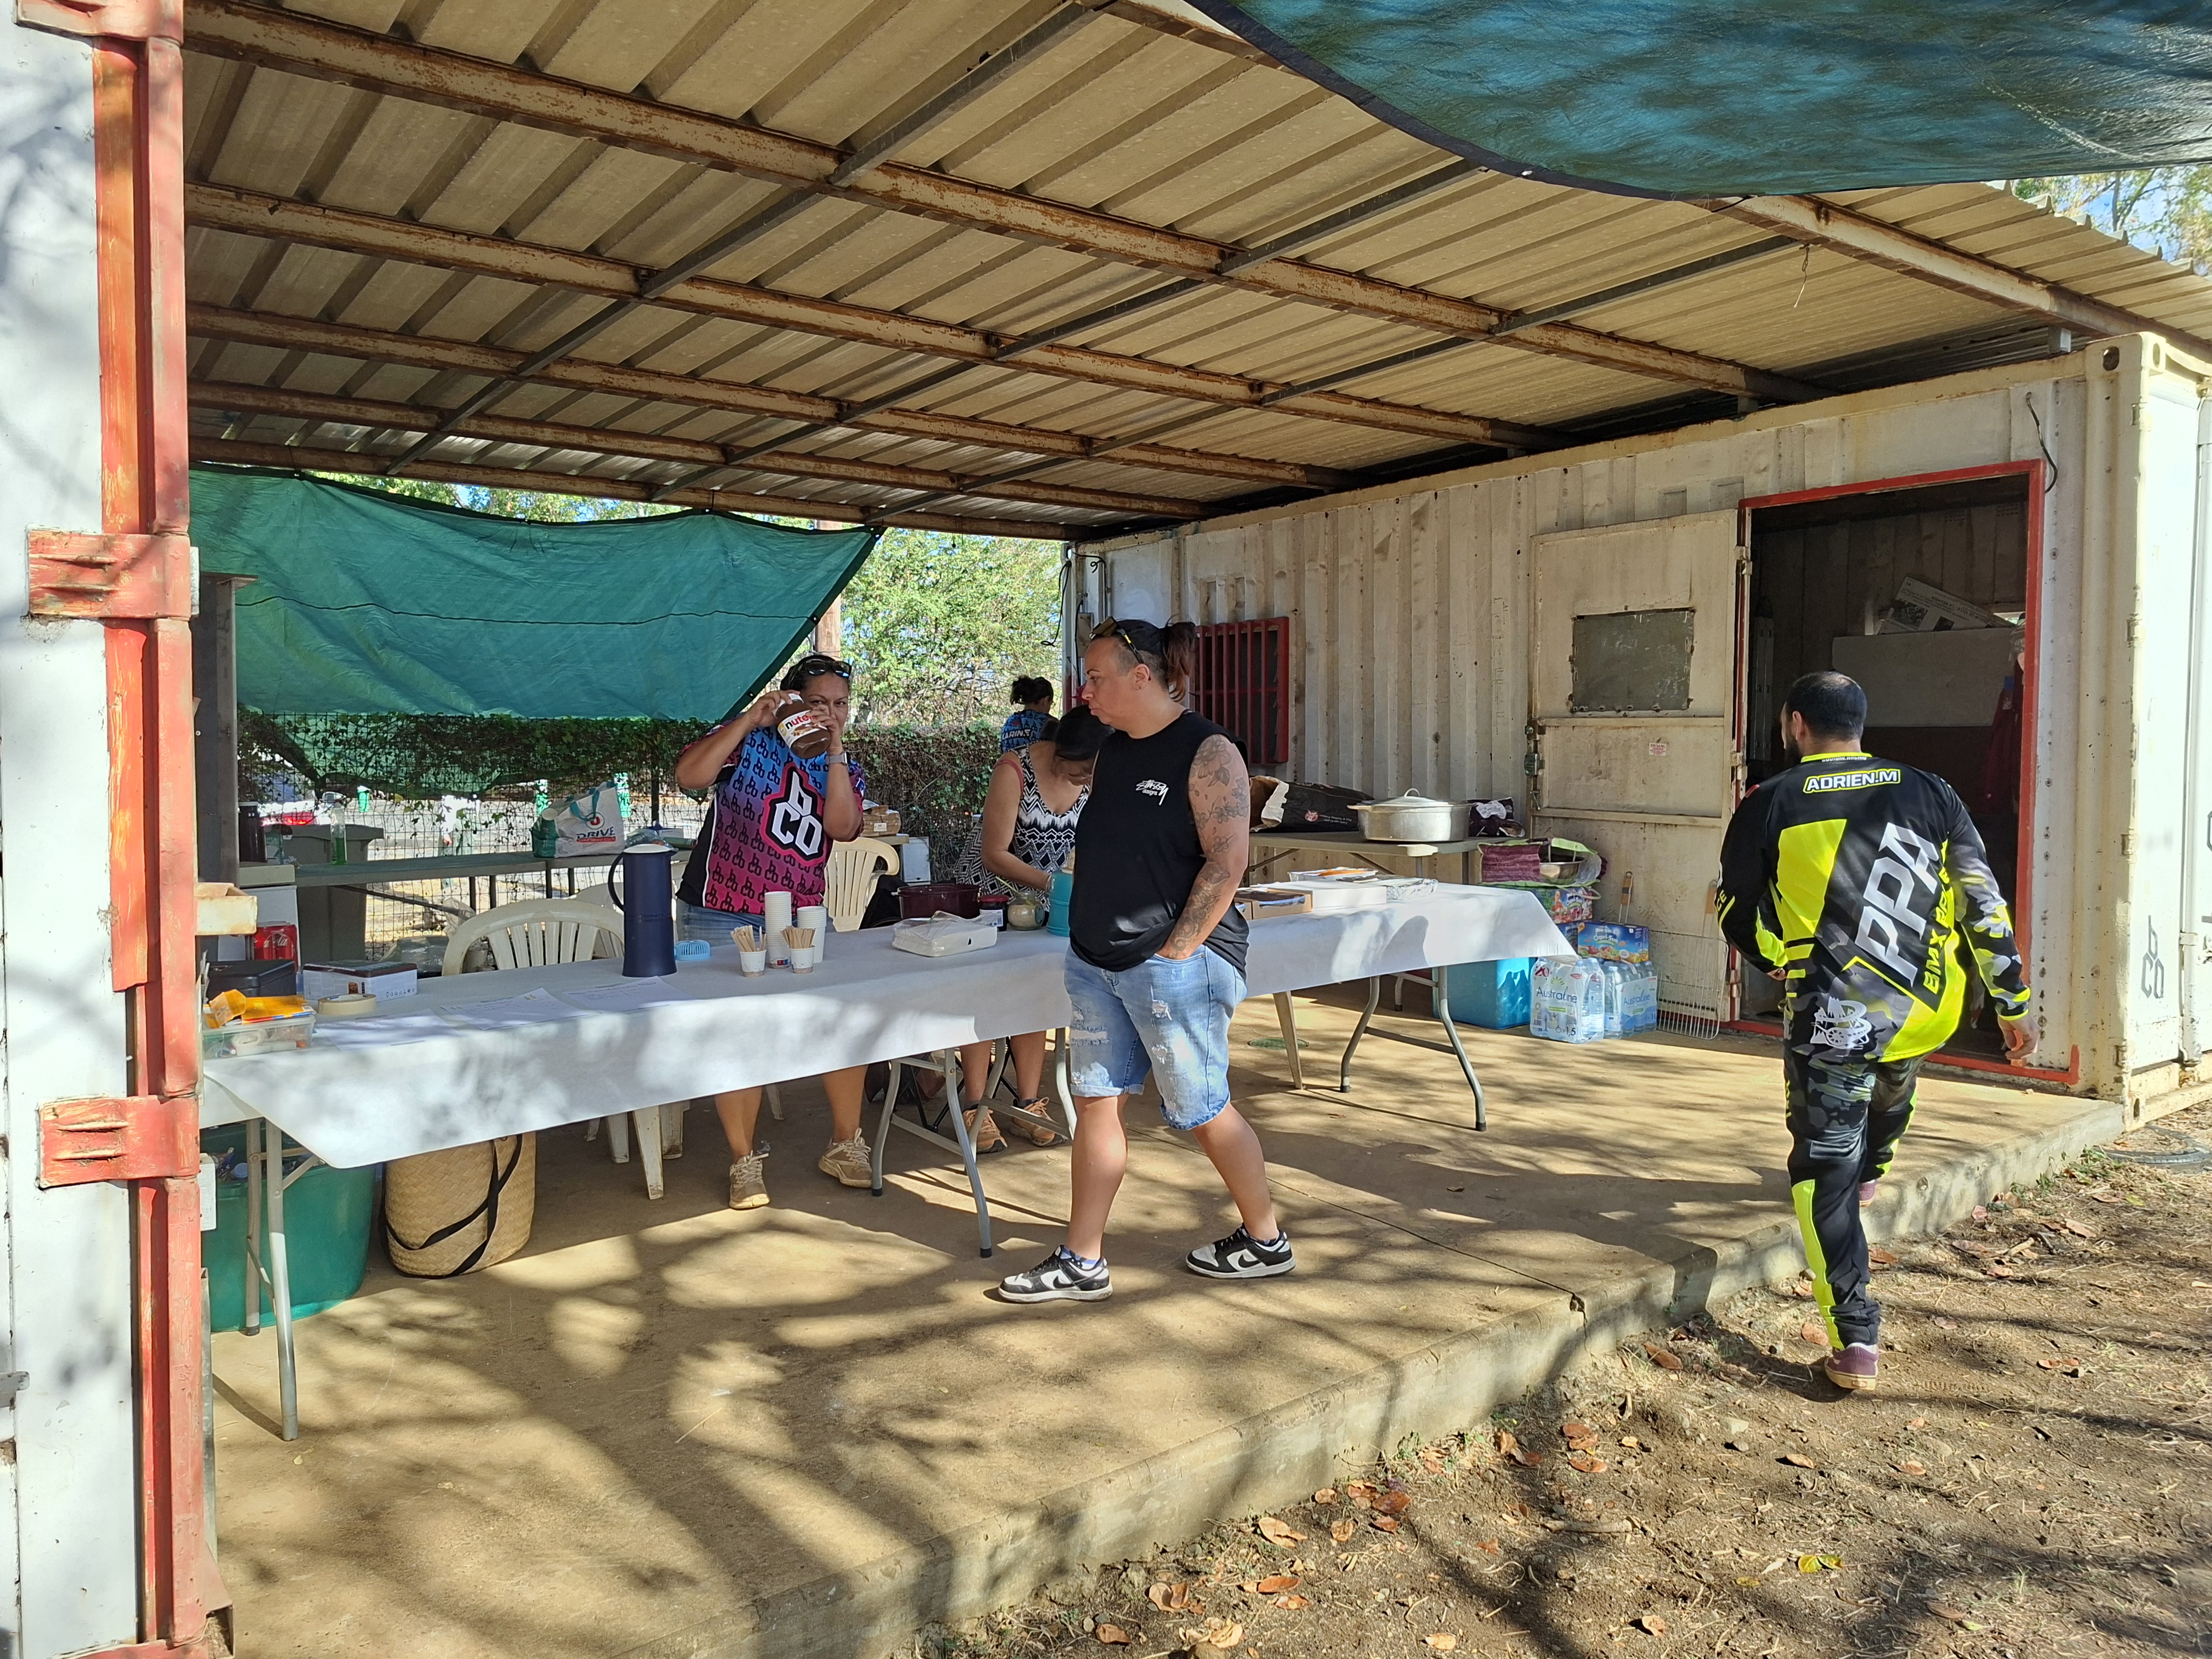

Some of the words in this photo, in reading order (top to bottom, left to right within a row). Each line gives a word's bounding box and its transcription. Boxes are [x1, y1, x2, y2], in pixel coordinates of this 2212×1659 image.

[1807, 771, 1897, 791] ADRIEN.M
[576, 826, 616, 839] DRIVE
[1593, 933, 1619, 943] Capri-Sun
[1923, 928, 1947, 994] BMX
[1536, 986, 1578, 1004] Australine
